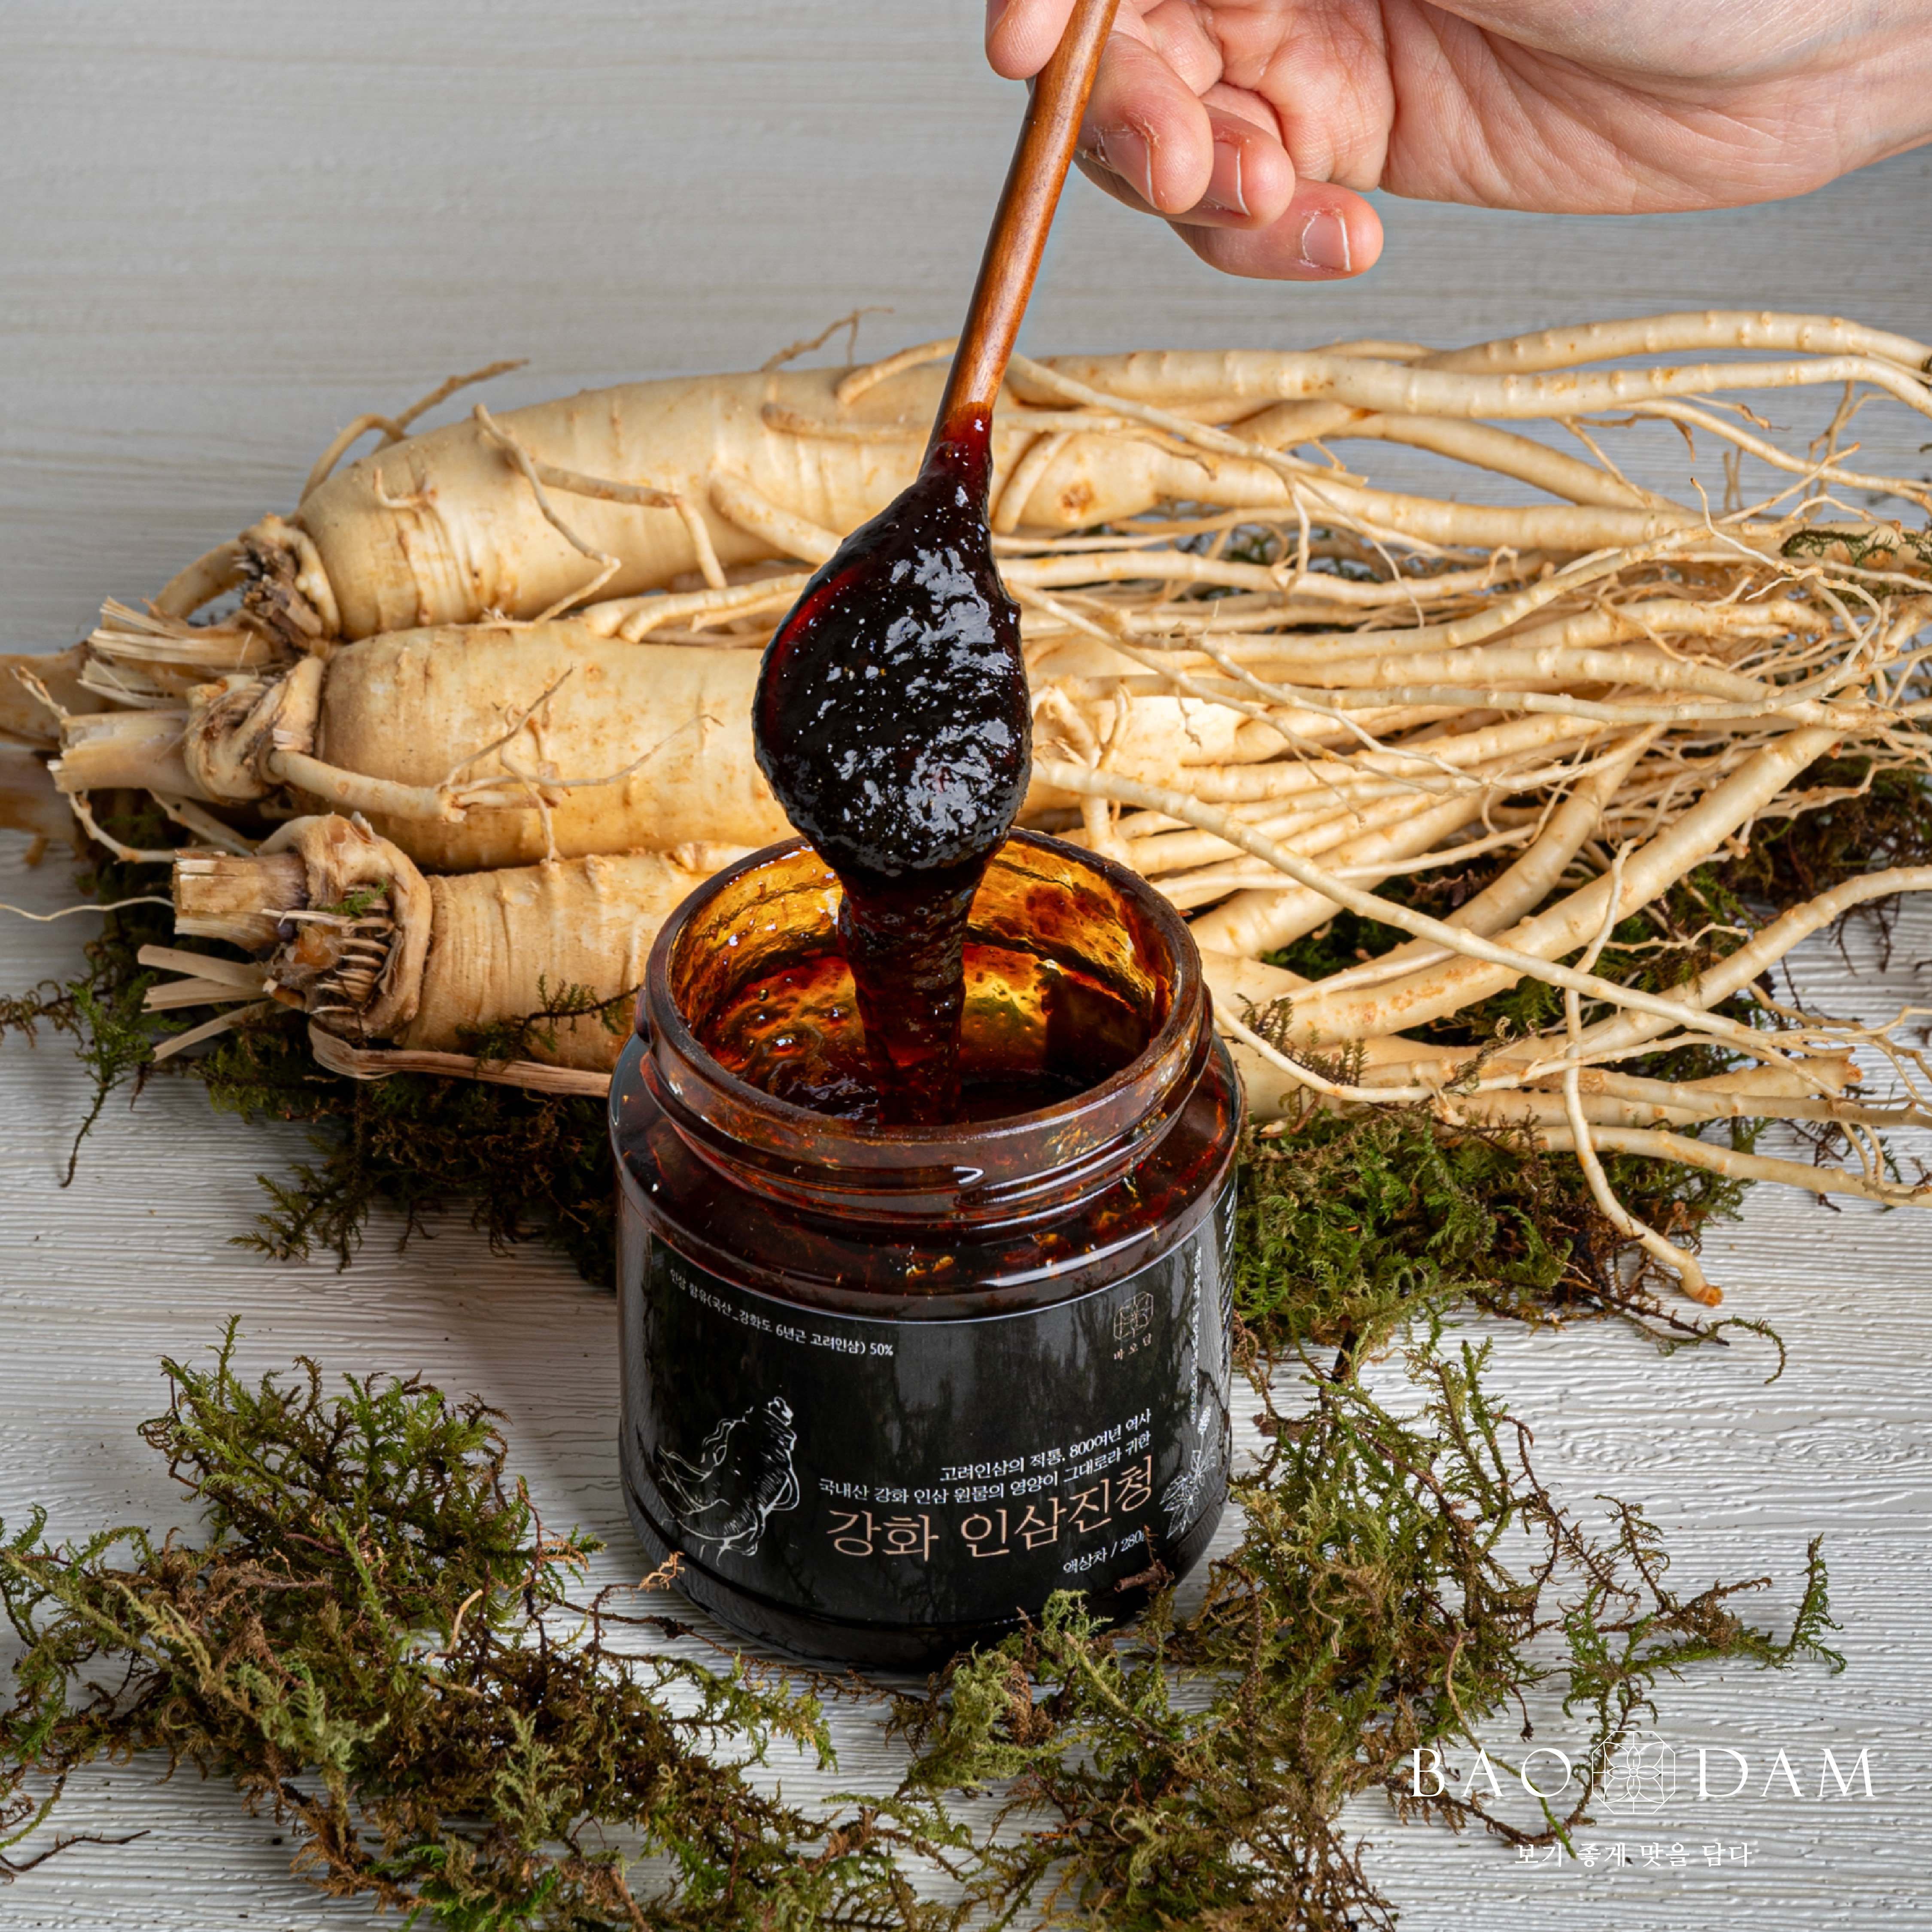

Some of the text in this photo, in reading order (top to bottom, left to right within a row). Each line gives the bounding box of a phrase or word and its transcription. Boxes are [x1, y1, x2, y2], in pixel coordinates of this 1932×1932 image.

[671, 1269, 686, 1290] 인삼
[776, 1324, 806, 1343] 6년근
[810, 1333, 865, 1355] 고려인삼)
[870, 1343, 893, 1356] 50%
[819, 1430, 1151, 1504] 국내산 강화 인삼 원물의 영양이 그대로라 귀한
[940, 1457, 1024, 1481] 고려인삼의
[1070, 1424, 1121, 1458] 800여년
[1126, 1408, 1151, 1431] 역사
[827, 1455, 1152, 1561] 강화 인삼진청
[1063, 1547, 1107, 1573] 액상차
[1111, 1541, 1117, 1558] /
